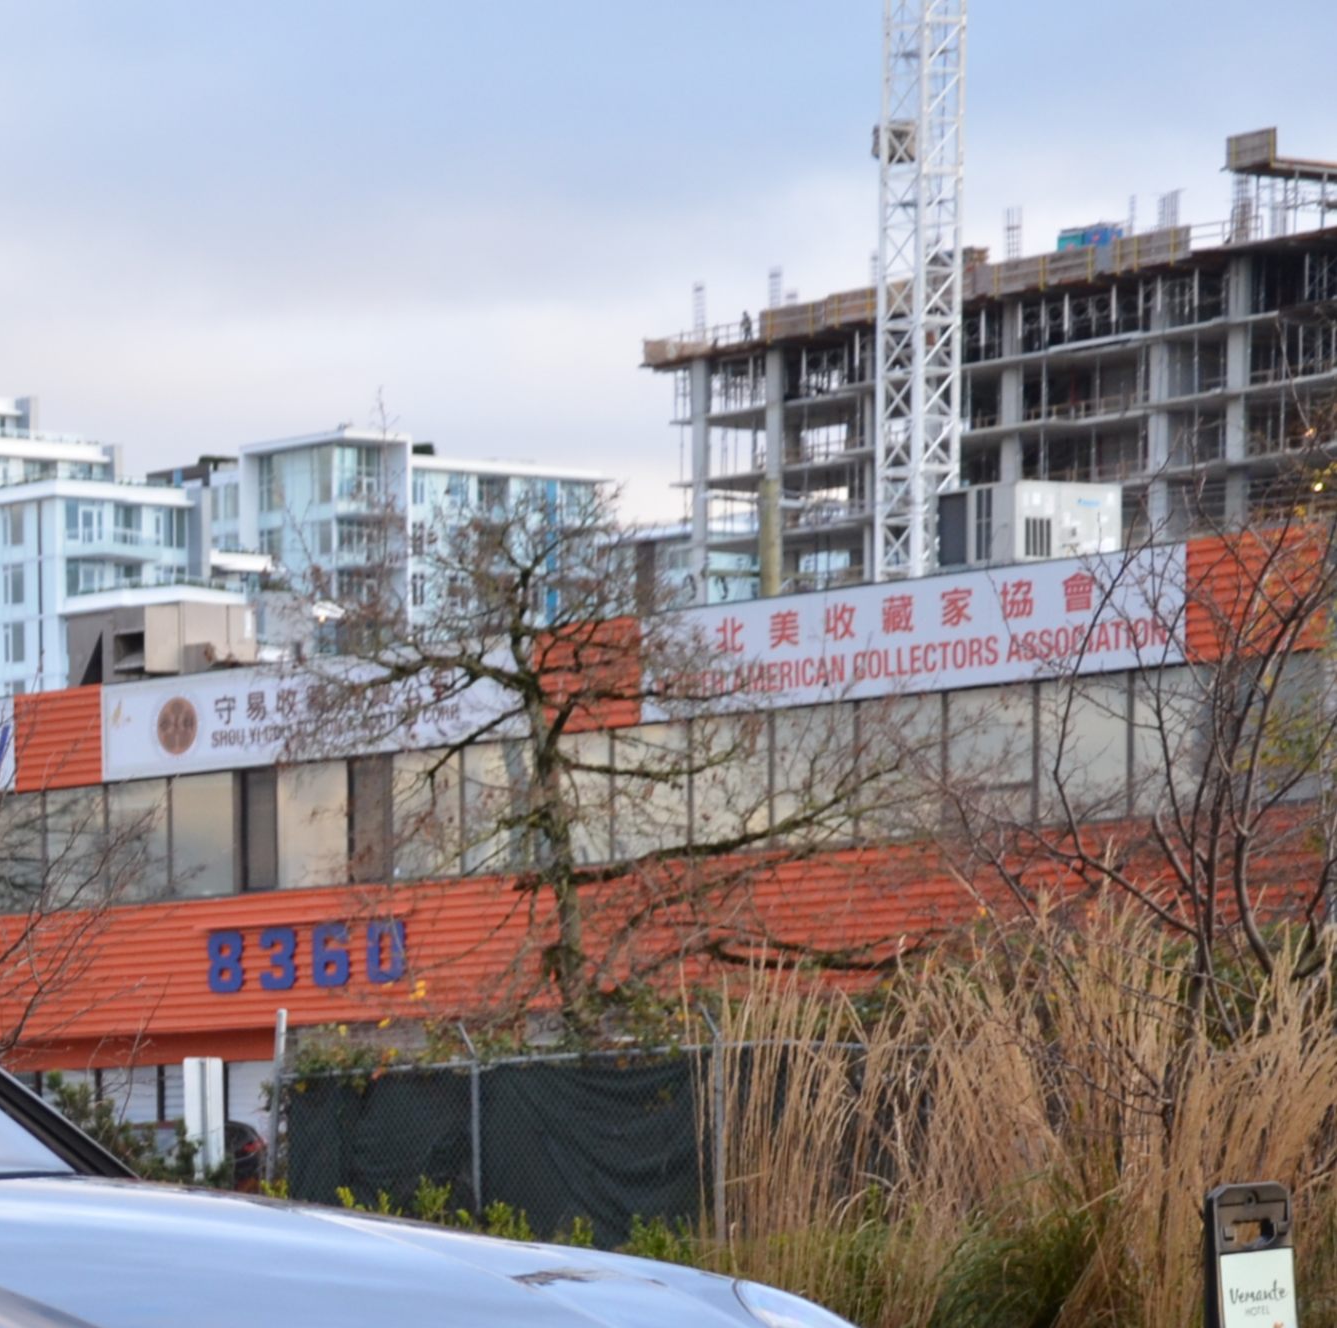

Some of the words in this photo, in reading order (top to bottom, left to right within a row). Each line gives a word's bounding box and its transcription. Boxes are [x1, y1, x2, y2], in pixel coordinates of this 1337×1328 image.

[714, 572, 1095, 653] 北美收藏家協會
[731, 652, 846, 694] AMERICAN
[853, 634, 999, 680] COLLECTORS
[1006, 615, 1168, 664] ASSOCIATION
[211, 728, 246, 749] SHOU
[207, 919, 408, 993] 8360
[1245, 1305, 1271, 1317] HOTEL
